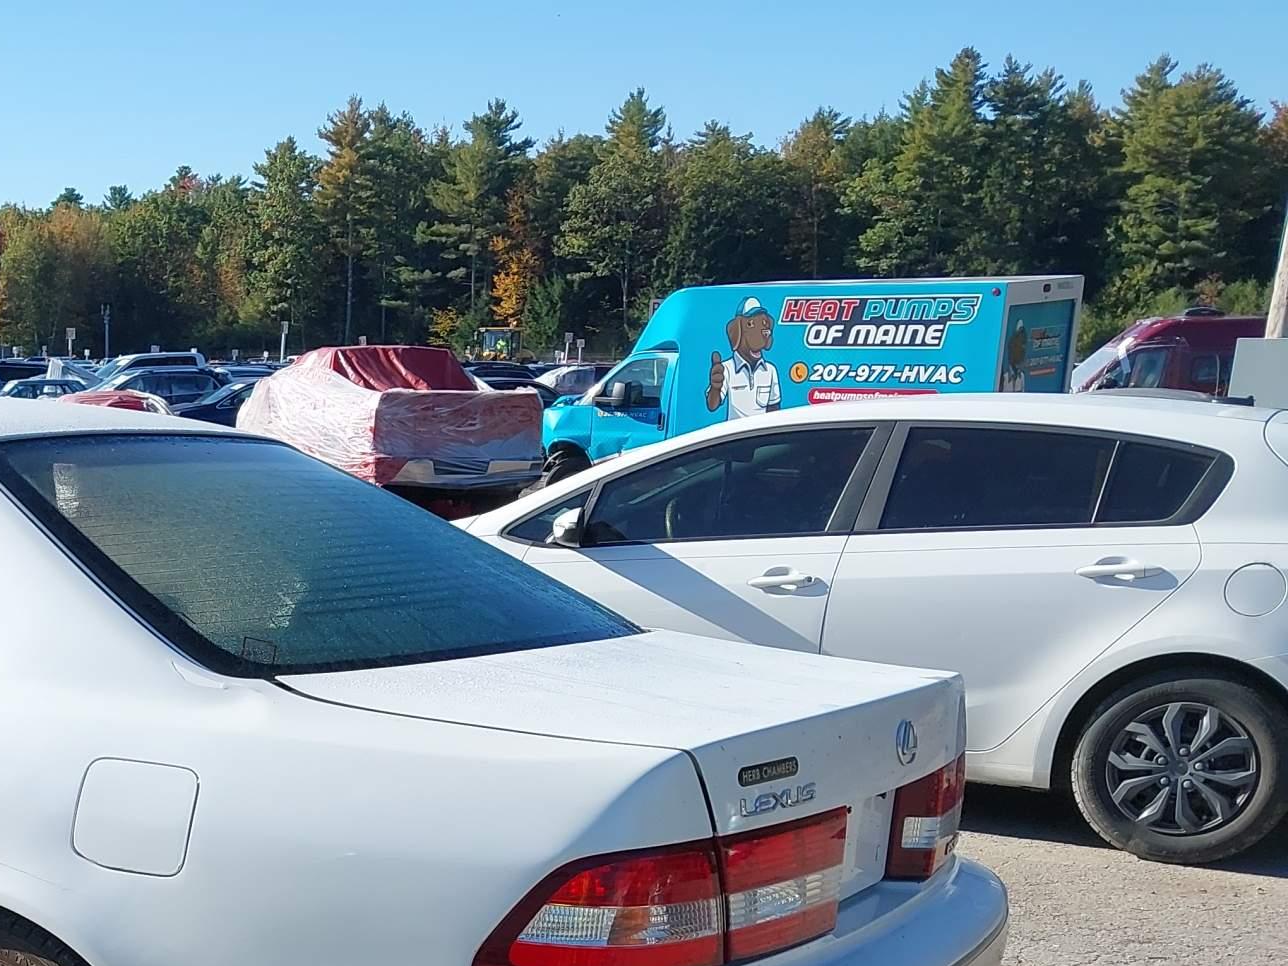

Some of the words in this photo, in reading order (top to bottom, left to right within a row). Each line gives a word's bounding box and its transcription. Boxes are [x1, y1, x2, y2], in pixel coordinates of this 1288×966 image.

[783, 299, 859, 321] HEAT
[863, 297, 978, 320] PUMPS
[807, 324, 844, 345] OF
[847, 323, 944, 345] MAINE
[809, 364, 965, 383] 207-977-HVAC
[742, 768, 761, 784] HERB
[762, 760, 797, 778] CHAMBERS
[740, 782, 817, 818] LEXUS
